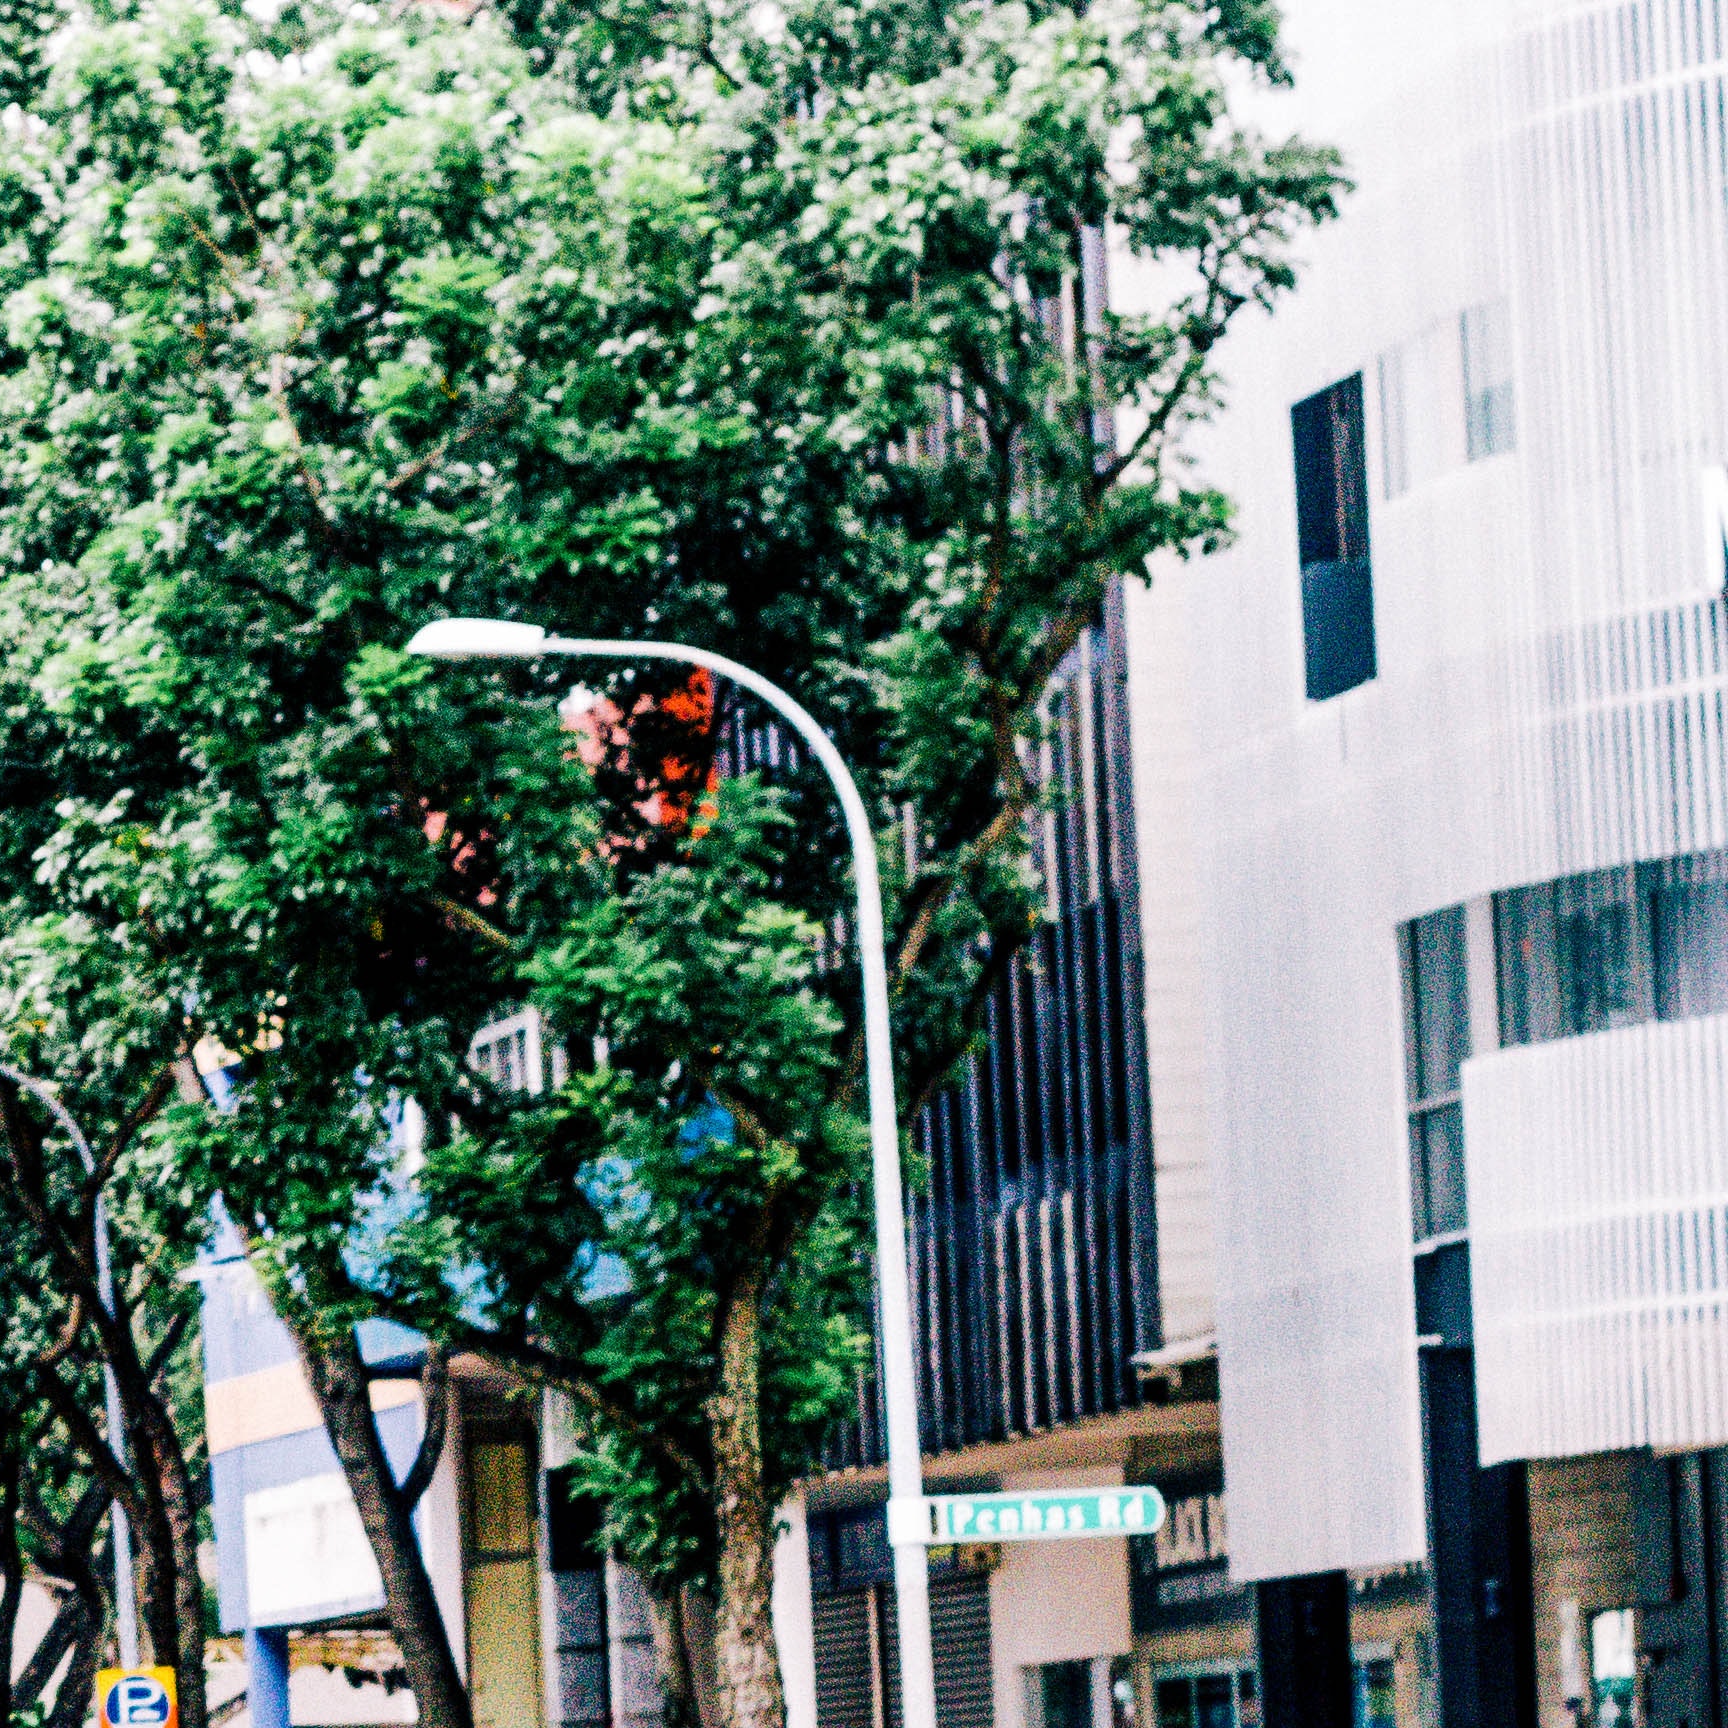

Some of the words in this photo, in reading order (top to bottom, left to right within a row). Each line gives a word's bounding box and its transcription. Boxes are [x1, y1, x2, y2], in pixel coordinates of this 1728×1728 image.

[952, 1500, 1085, 1535] Penhas
[1098, 1494, 1145, 1529] Rd
[119, 1682, 162, 1727] P
